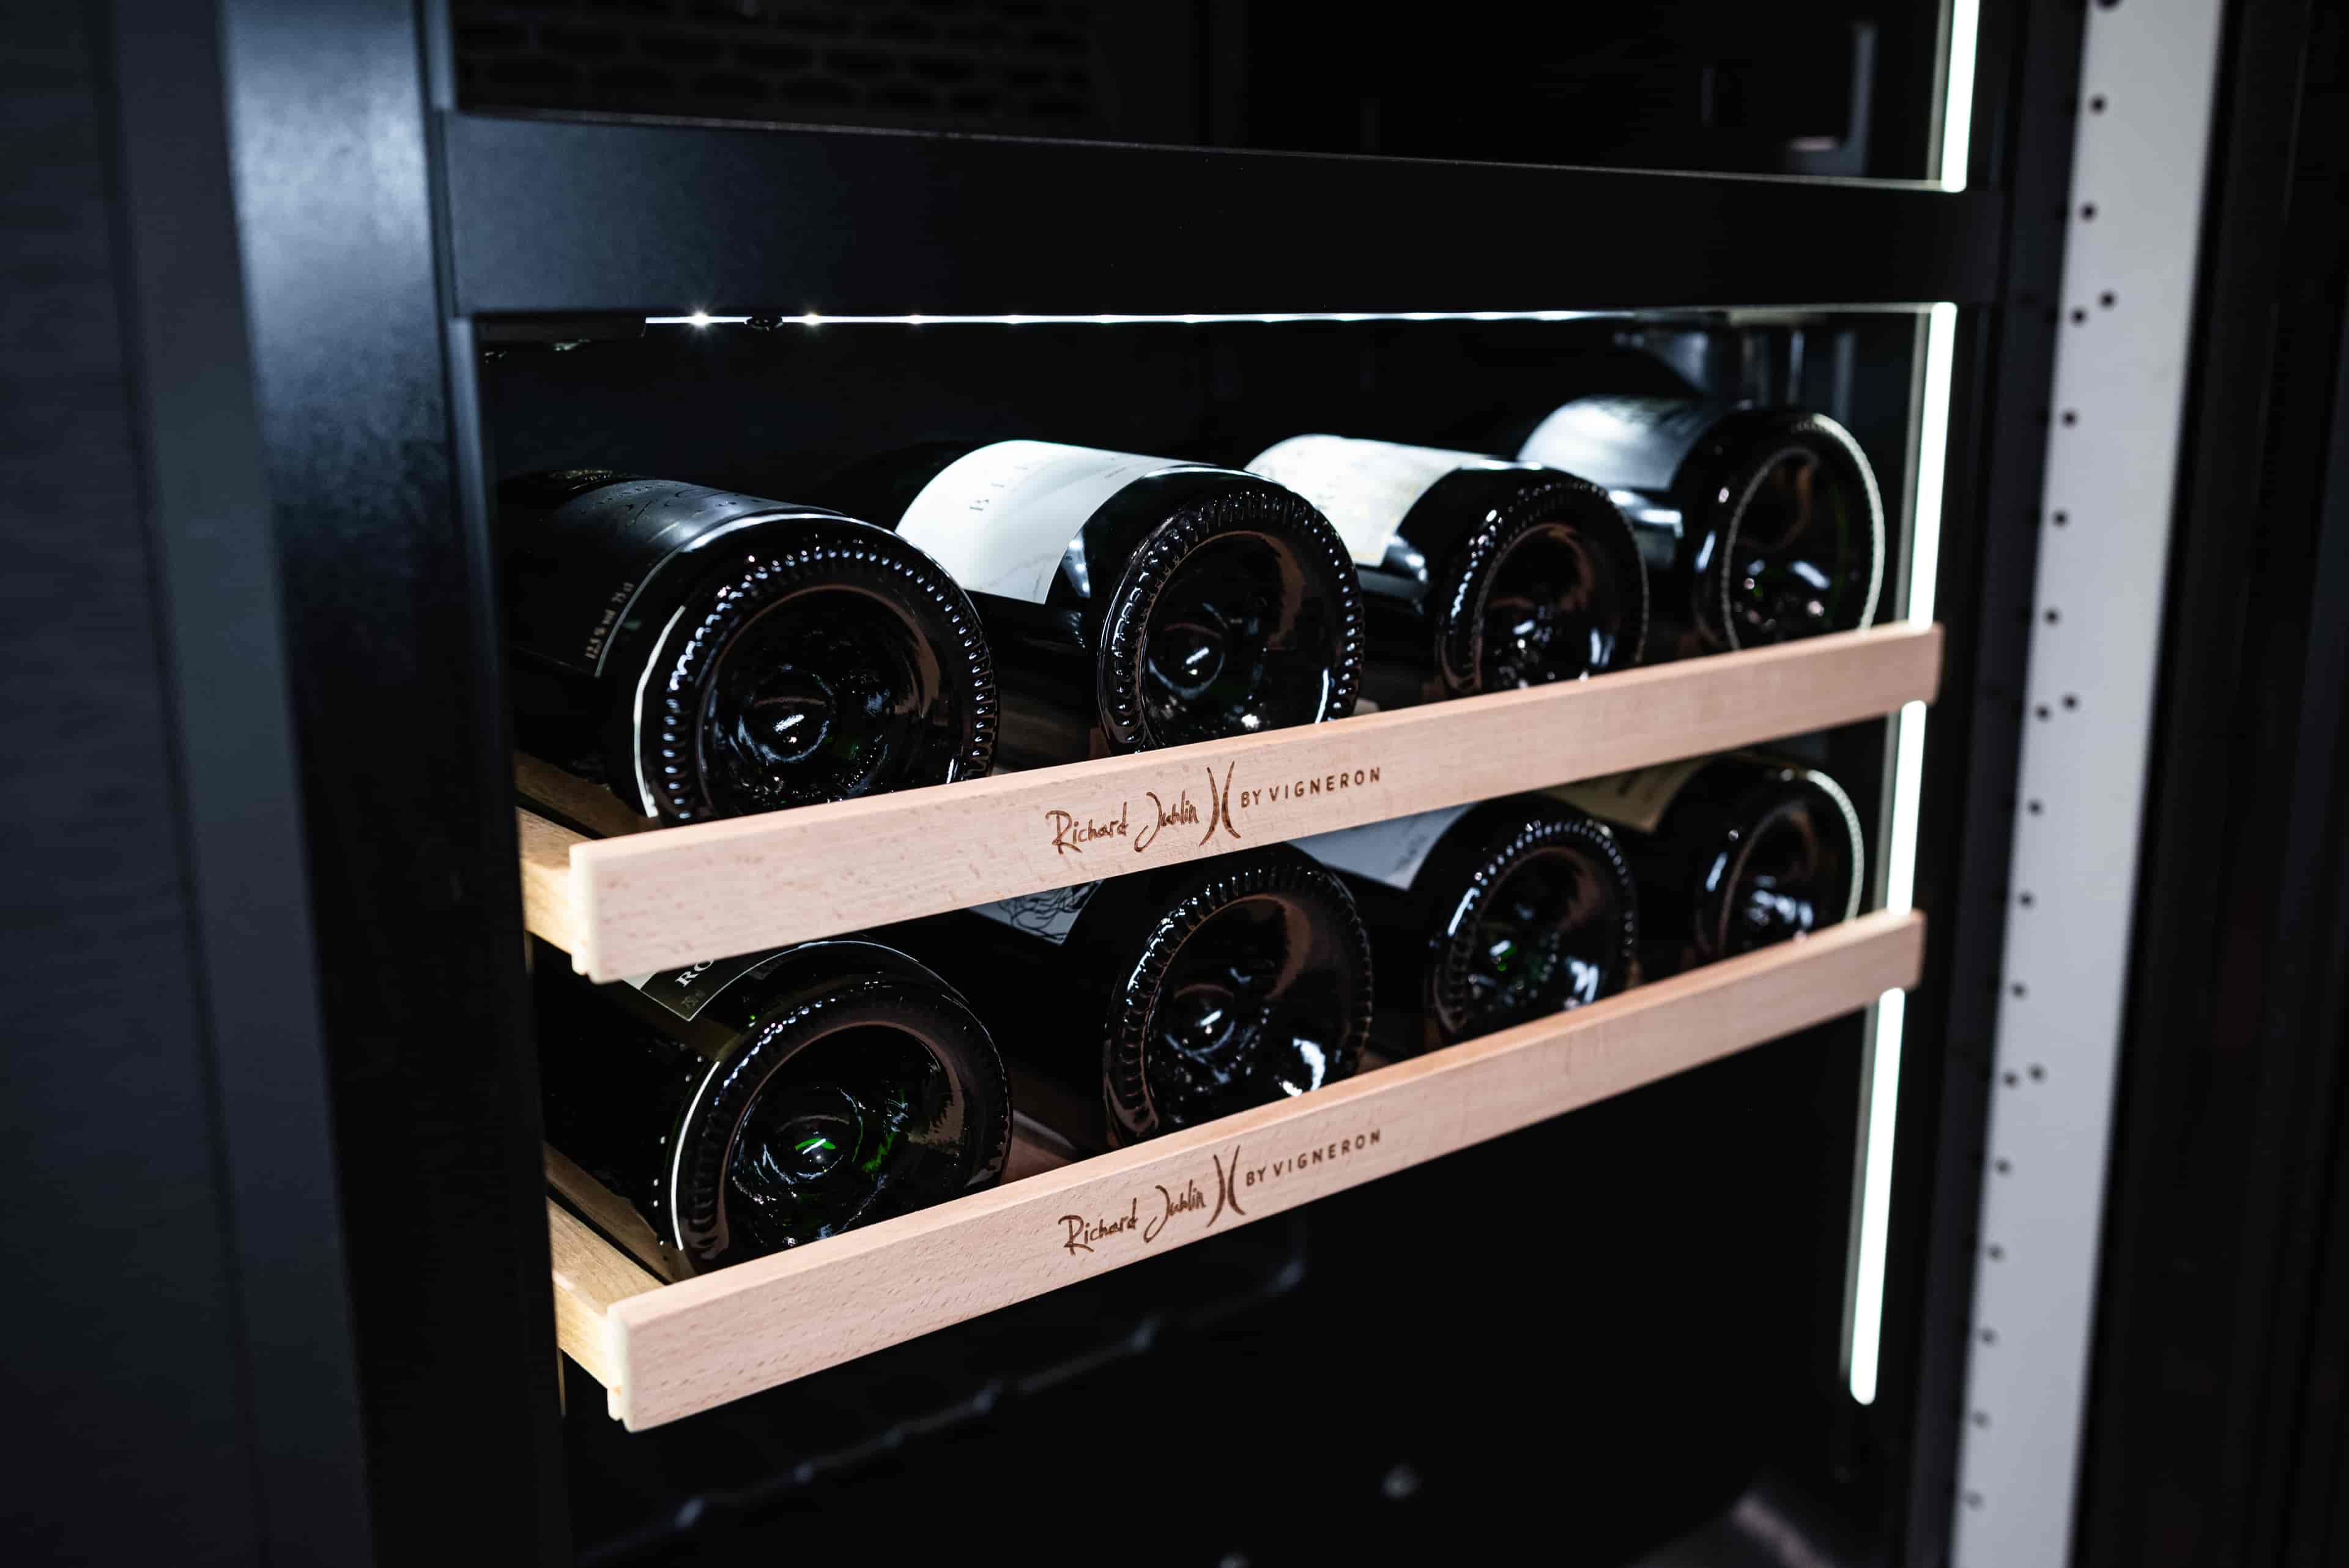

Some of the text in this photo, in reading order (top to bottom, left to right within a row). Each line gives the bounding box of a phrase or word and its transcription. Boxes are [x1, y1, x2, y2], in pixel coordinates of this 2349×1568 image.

[1241, 767, 1381, 808] BY VIGNERON
[1045, 801, 1129, 855] Richard
[1245, 1129, 1381, 1187] BY VIGNERON
[1057, 1197, 1139, 1257] Richard
